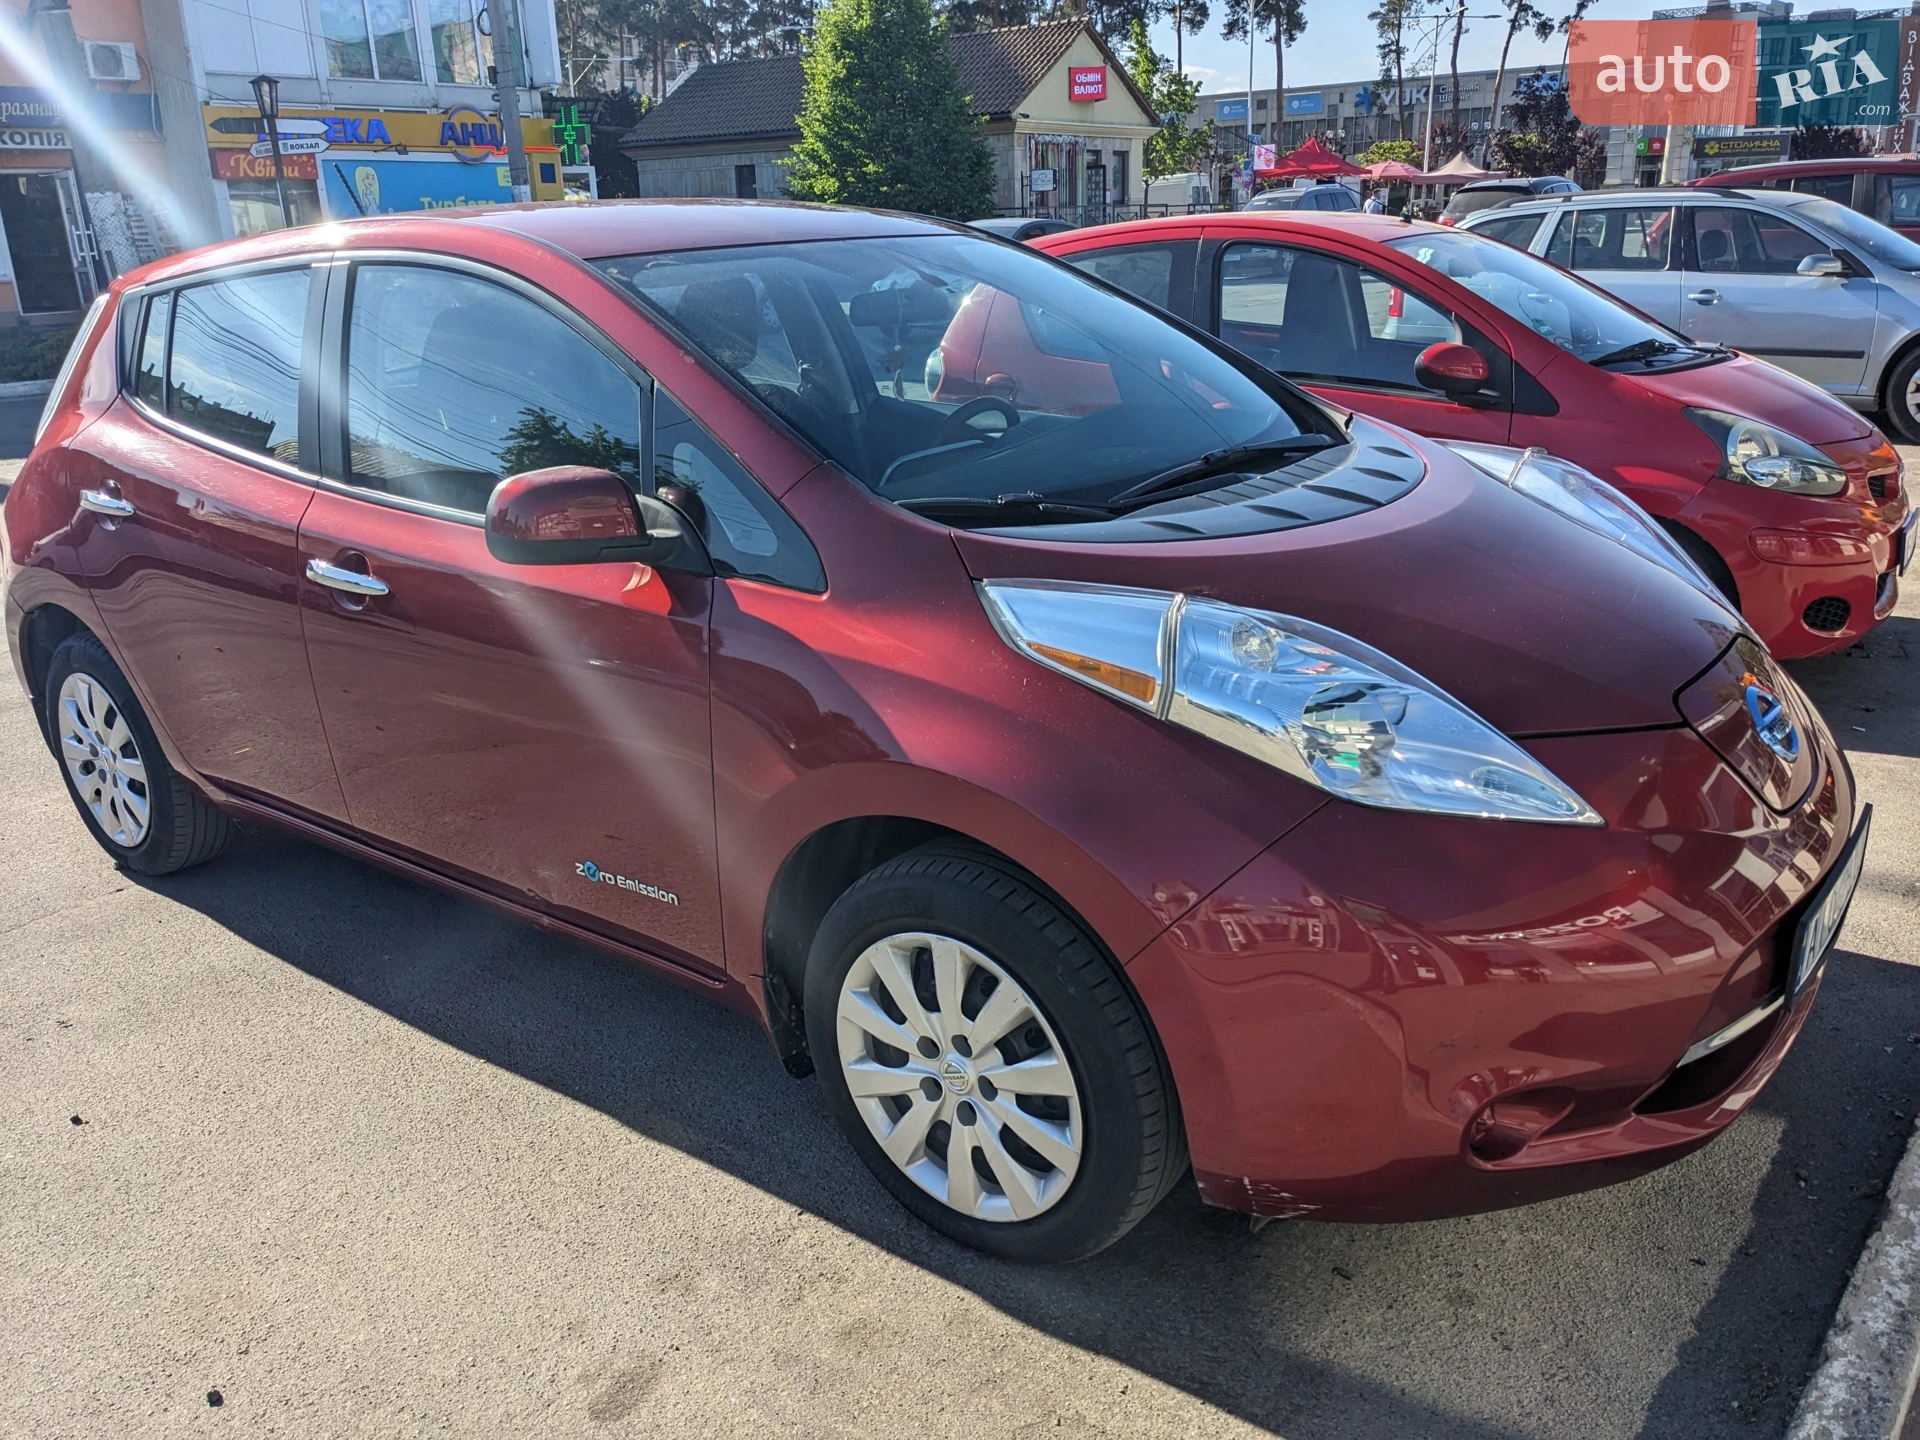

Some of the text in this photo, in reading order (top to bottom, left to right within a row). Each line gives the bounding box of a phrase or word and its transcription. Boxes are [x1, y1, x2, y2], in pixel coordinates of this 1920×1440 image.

[1075, 72, 1101, 83] ОБМІН
[1074, 84, 1103, 95] ВАЛЮТ
[1439, 94, 1470, 103] Шонг
[440, 121, 502, 151] АНЦ
[289, 142, 320, 151] ВОКЗАЛ
[1720, 139, 1781, 149] СТОЛИЧНА
[574, 861, 679, 906] zero Emission
